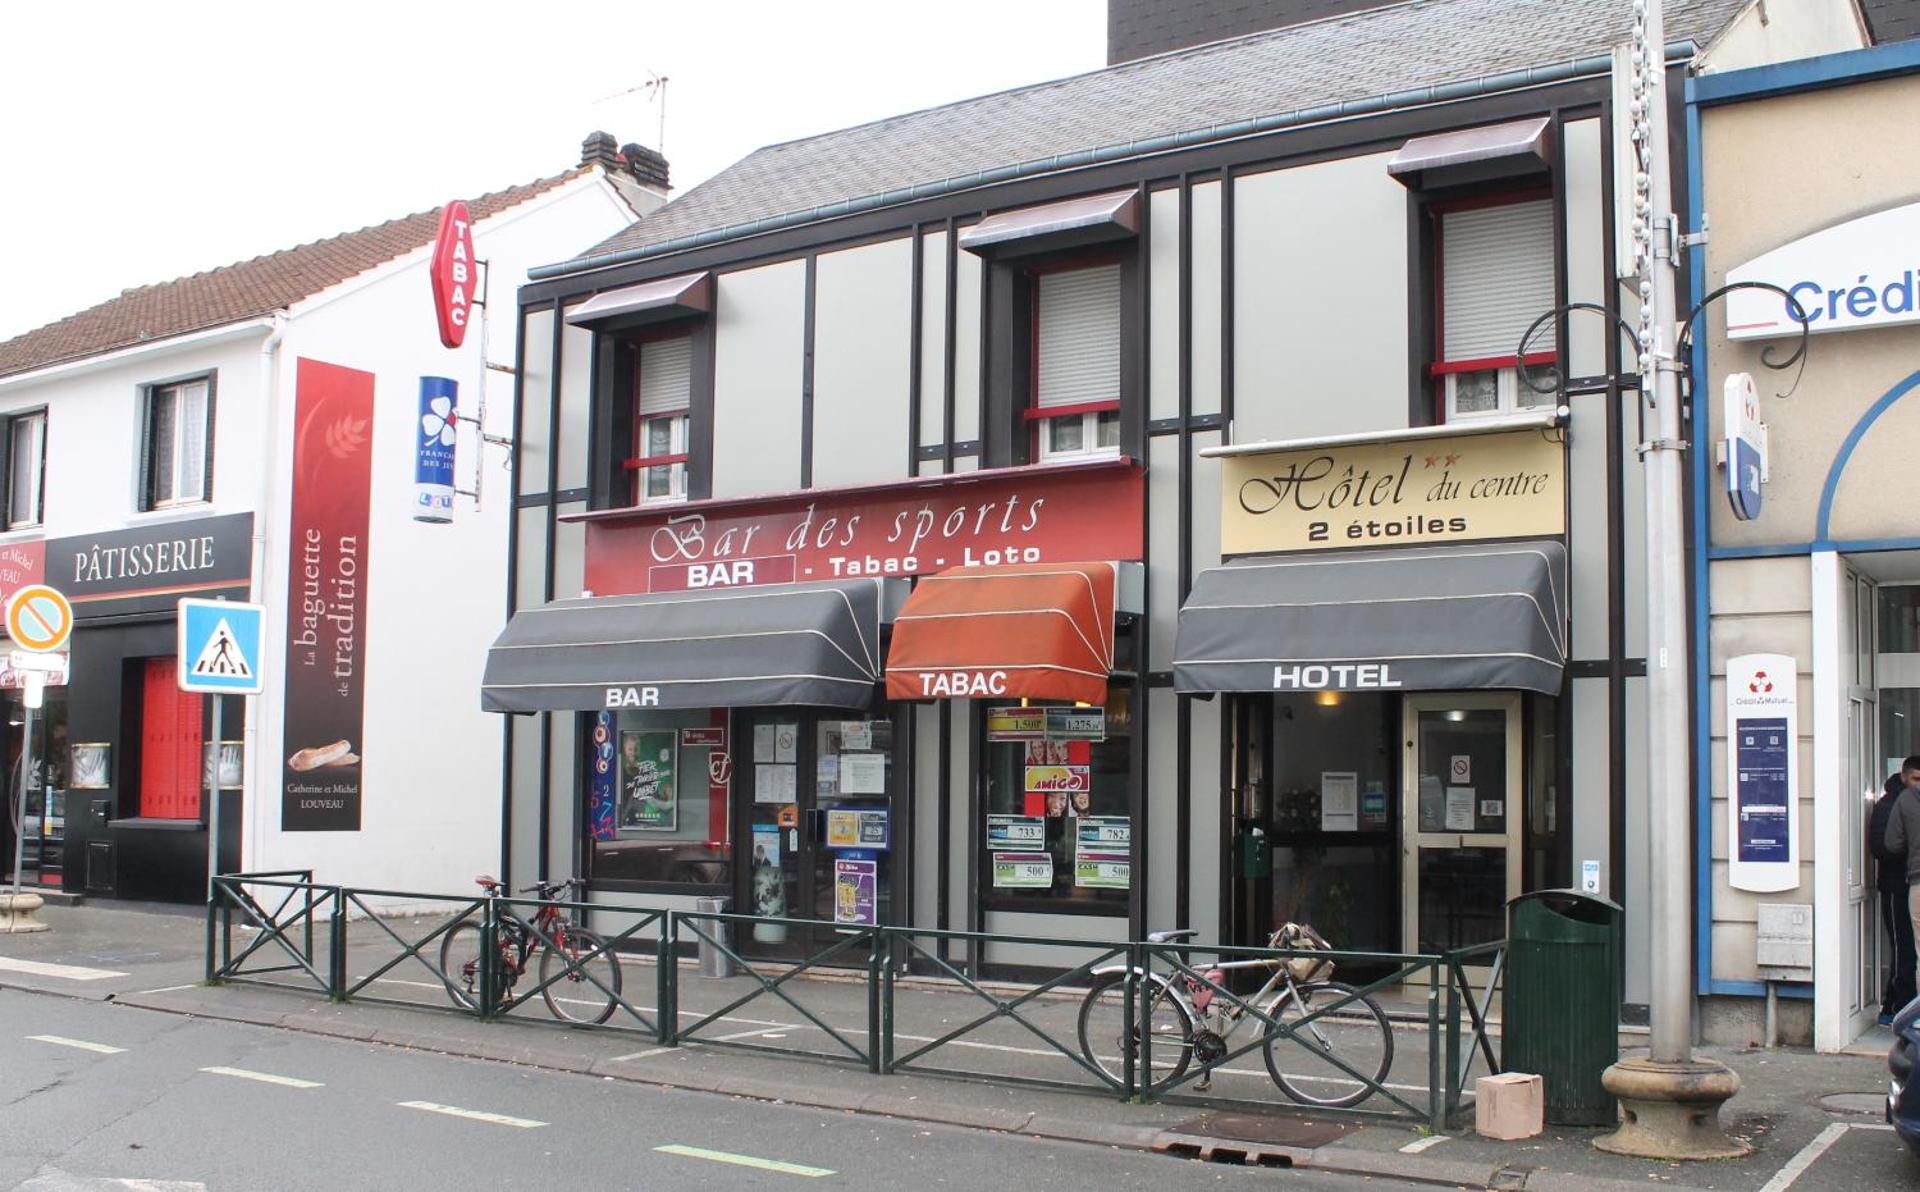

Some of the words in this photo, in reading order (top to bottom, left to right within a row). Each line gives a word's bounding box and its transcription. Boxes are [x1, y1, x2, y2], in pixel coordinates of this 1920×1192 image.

[451, 220, 468, 326] TABAC
[1239, 454, 1413, 515] Hôtel
[1426, 469, 1462, 503] du
[1470, 471, 1549, 499] centre
[650, 514, 759, 562] Bar
[787, 504, 859, 551] des
[888, 494, 1044, 552] sports
[1309, 522, 1329, 541] 2
[1347, 515, 1467, 540] étoiles
[74, 535, 216, 583] PÂTISSERIE
[687, 560, 754, 587] BAR
[829, 554, 918, 577] Tabac
[964, 545, 1041, 568] Loto
[294, 528, 325, 647] baguette
[327, 535, 357, 679] tradition
[306, 651, 315, 666] La
[337, 682, 348, 697] de
[919, 671, 1007, 696] TABAC
[1273, 664, 1402, 689] HOTEL
[605, 687, 659, 707] BAR
[333, 784, 358, 793] Michel
[301, 799, 344, 809] LOUVEAU
